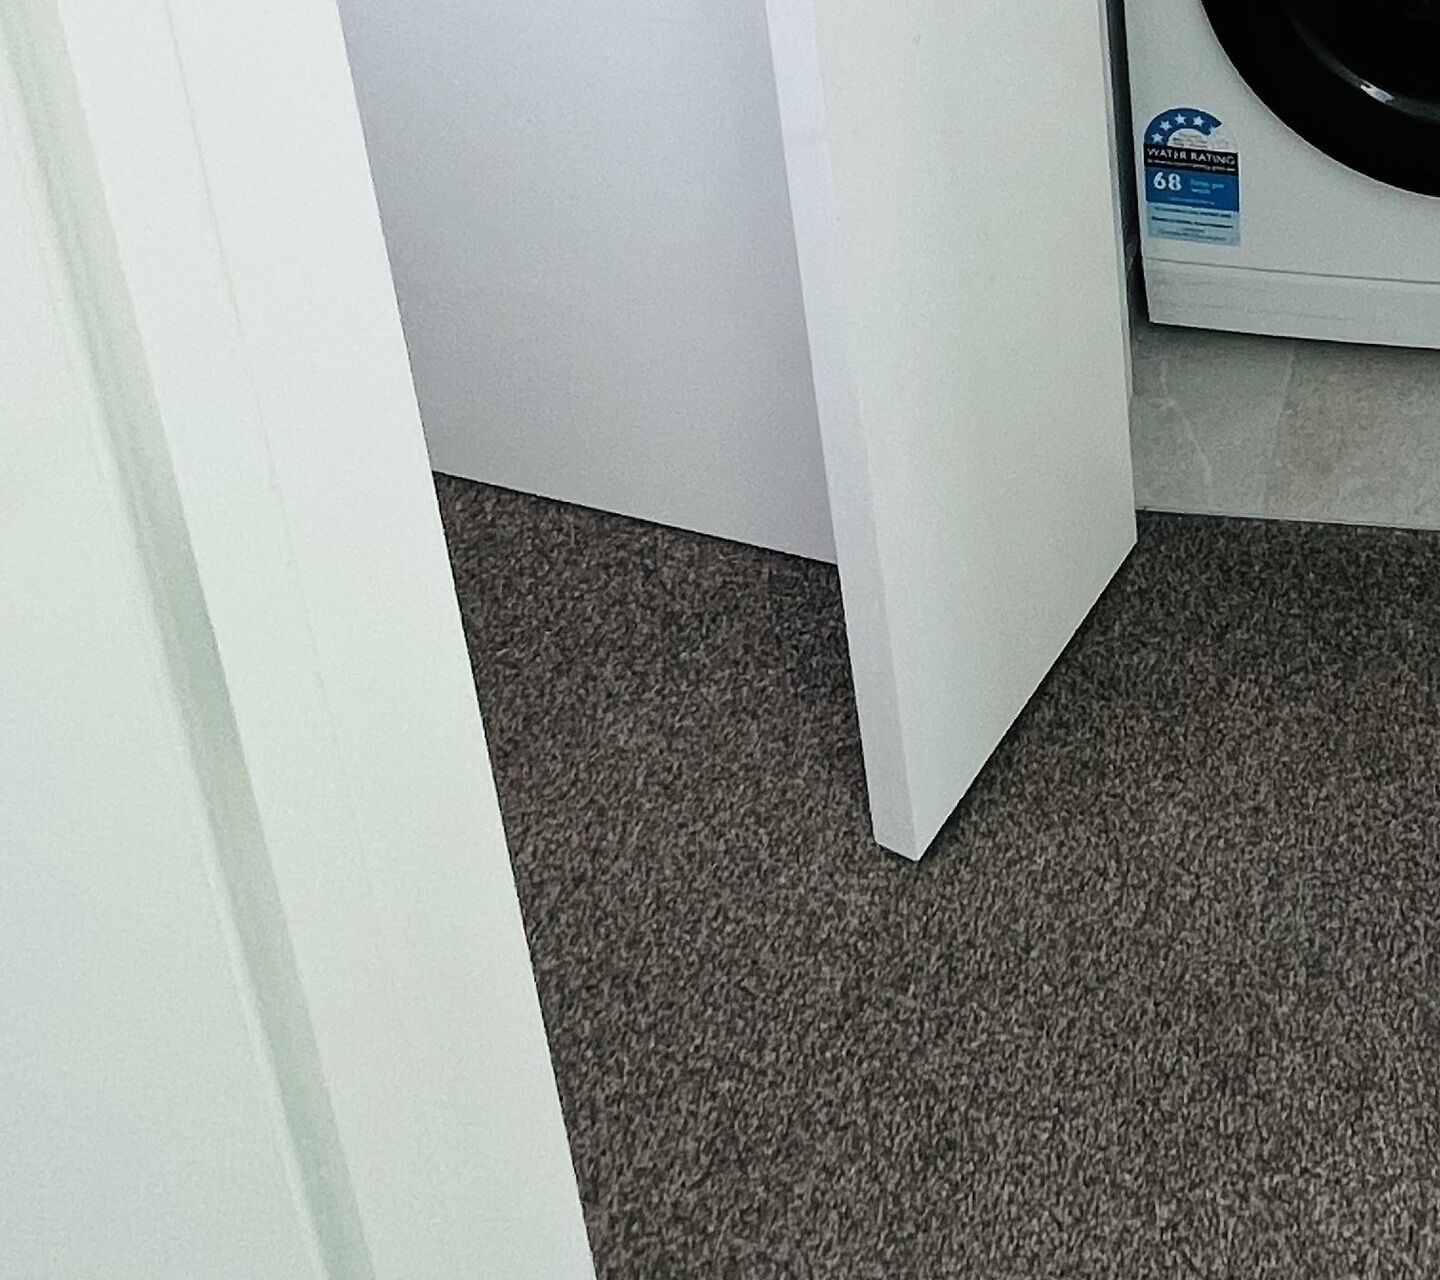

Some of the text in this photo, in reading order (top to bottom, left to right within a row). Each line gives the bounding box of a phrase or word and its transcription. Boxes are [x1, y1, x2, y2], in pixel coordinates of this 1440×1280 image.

[1147, 148, 1187, 160] WATER
[1190, 151, 1236, 166] RATING
[1153, 171, 1182, 191] 68
